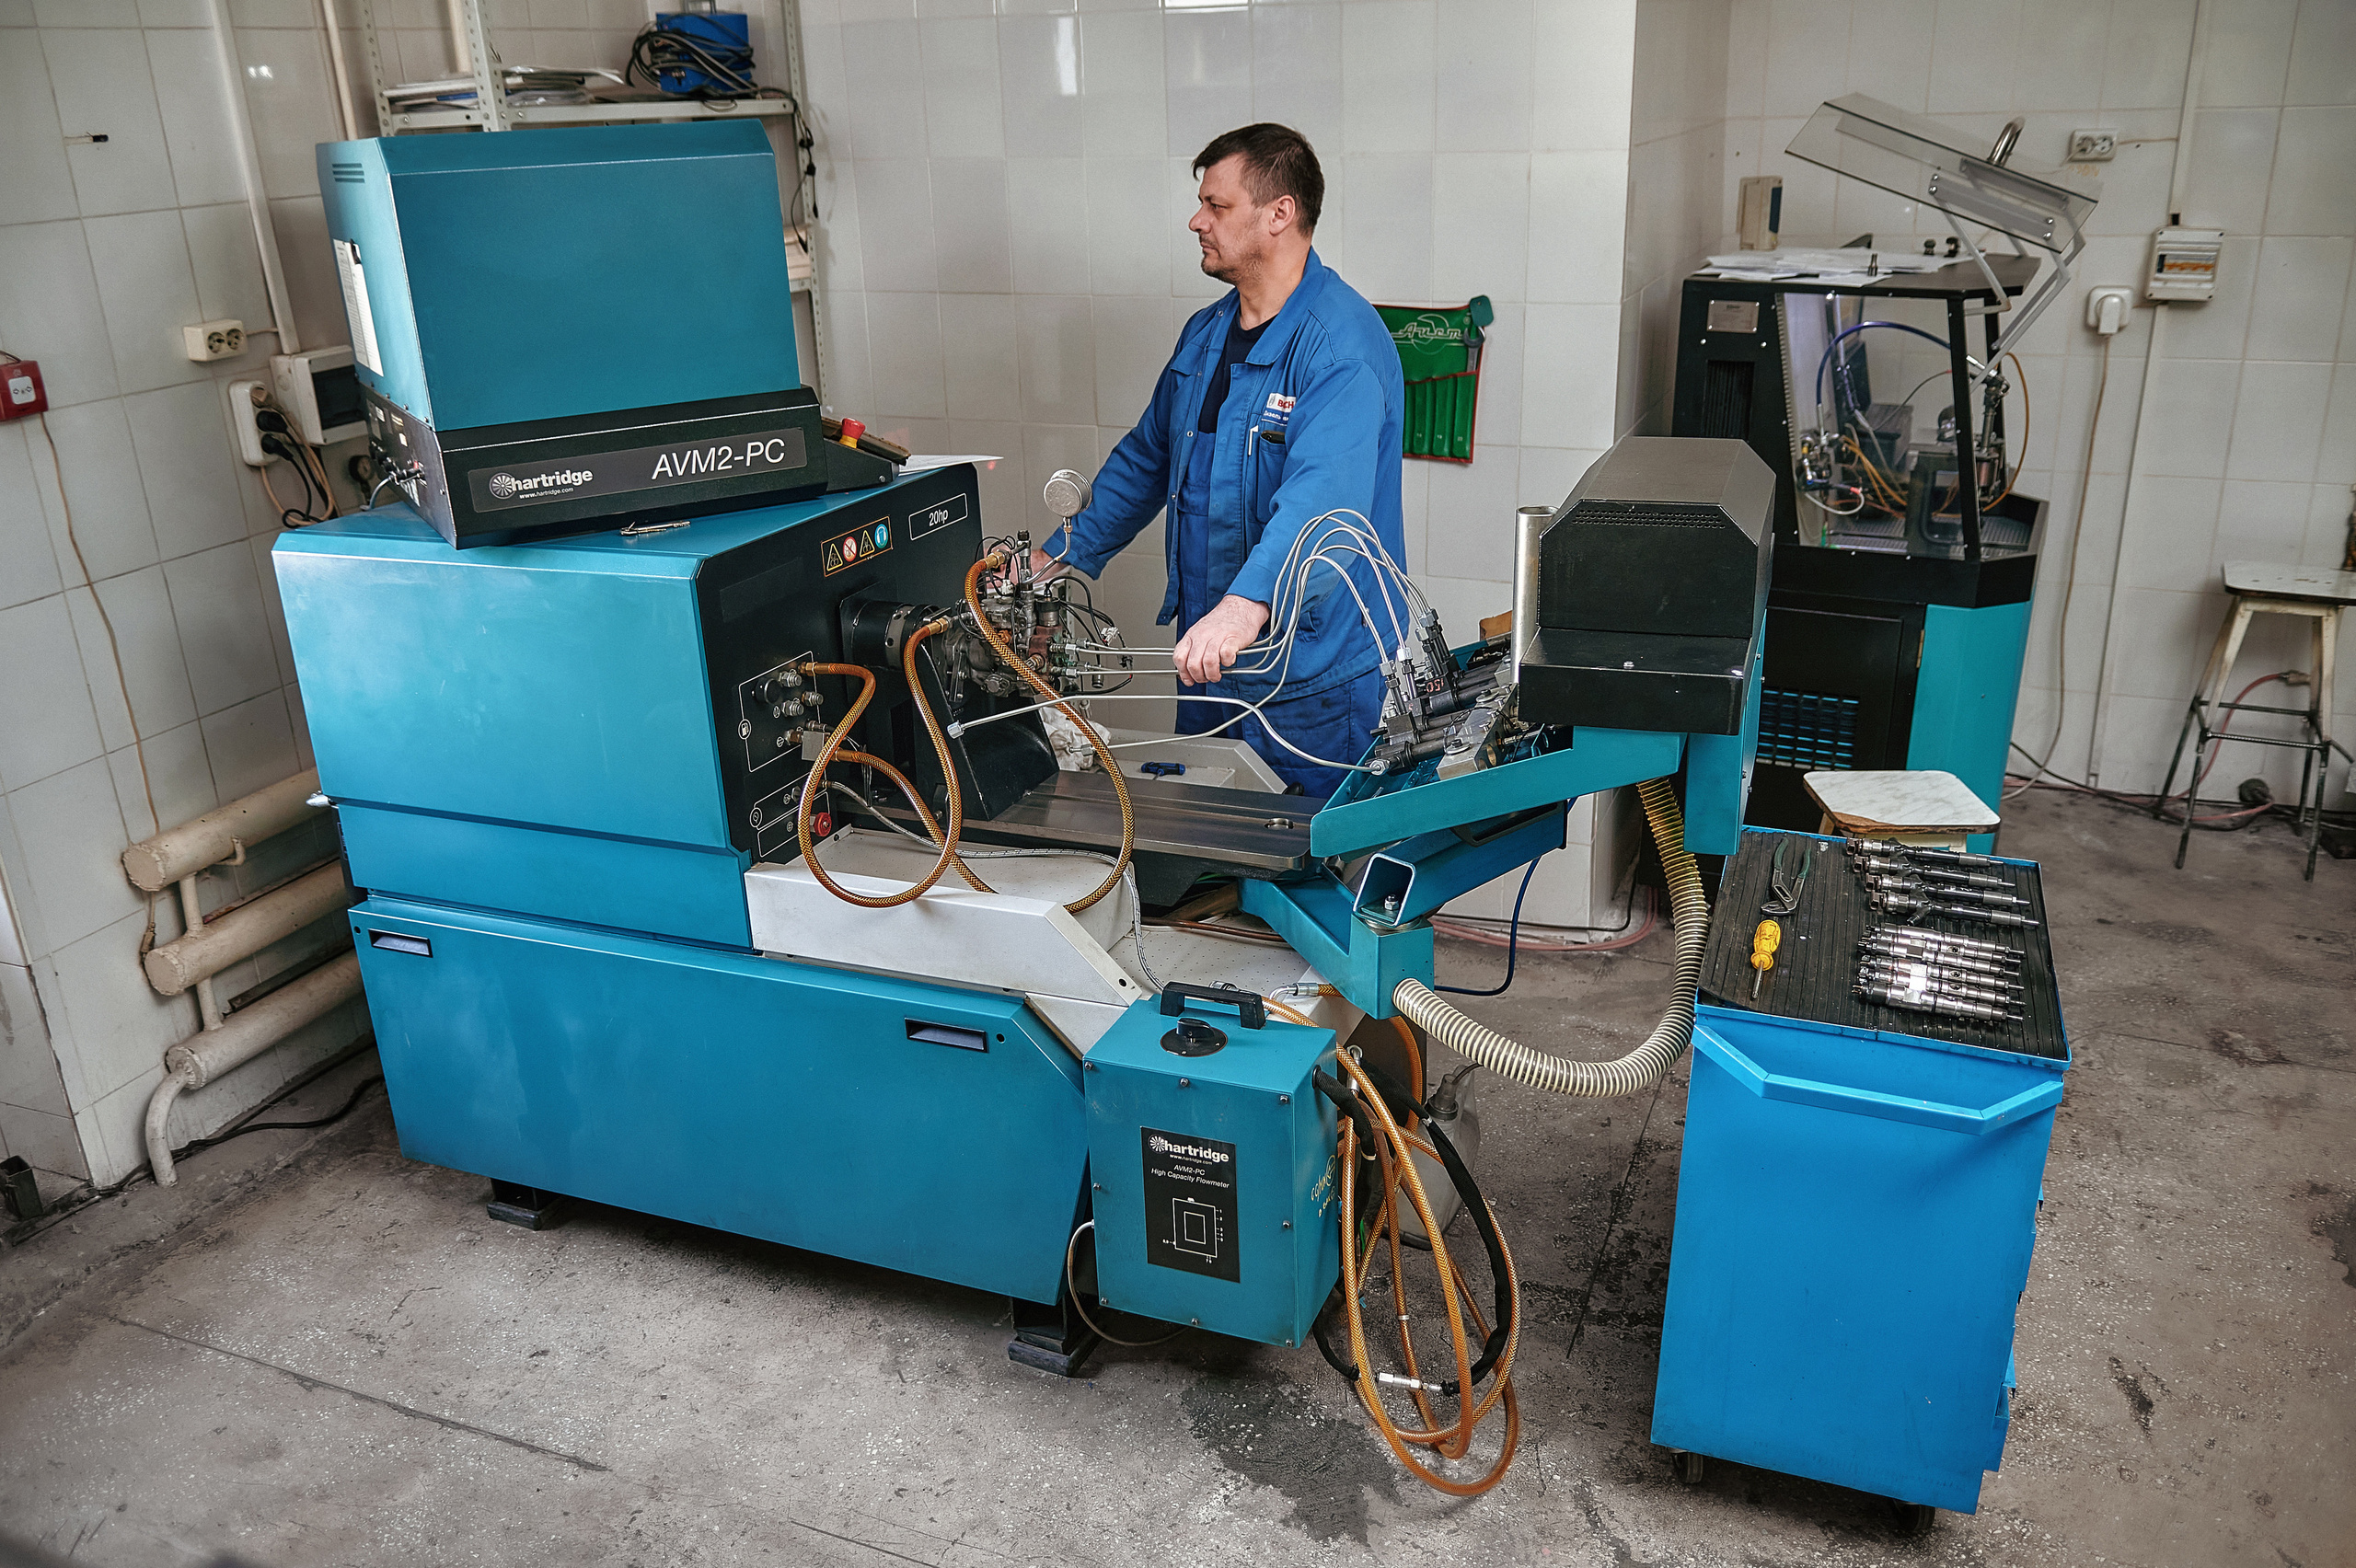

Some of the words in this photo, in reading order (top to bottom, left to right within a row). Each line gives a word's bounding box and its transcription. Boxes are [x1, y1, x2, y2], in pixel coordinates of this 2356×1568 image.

[652, 438, 786, 480] AVM2-PC
[512, 469, 594, 492] hartridge
[519, 487, 574, 500] www.hartridge.com
[929, 509, 949, 527] 20hp
[1164, 1140, 1230, 1163] hartridge
[1169, 1153, 1213, 1166] www.hartridge.com
[1150, 1168, 1166, 1177] High
[1167, 1170, 1195, 1183] Capacity
[1195, 1176, 1230, 1189] Flowmeter
[1173, 1164, 1206, 1176] AVM2-PC
